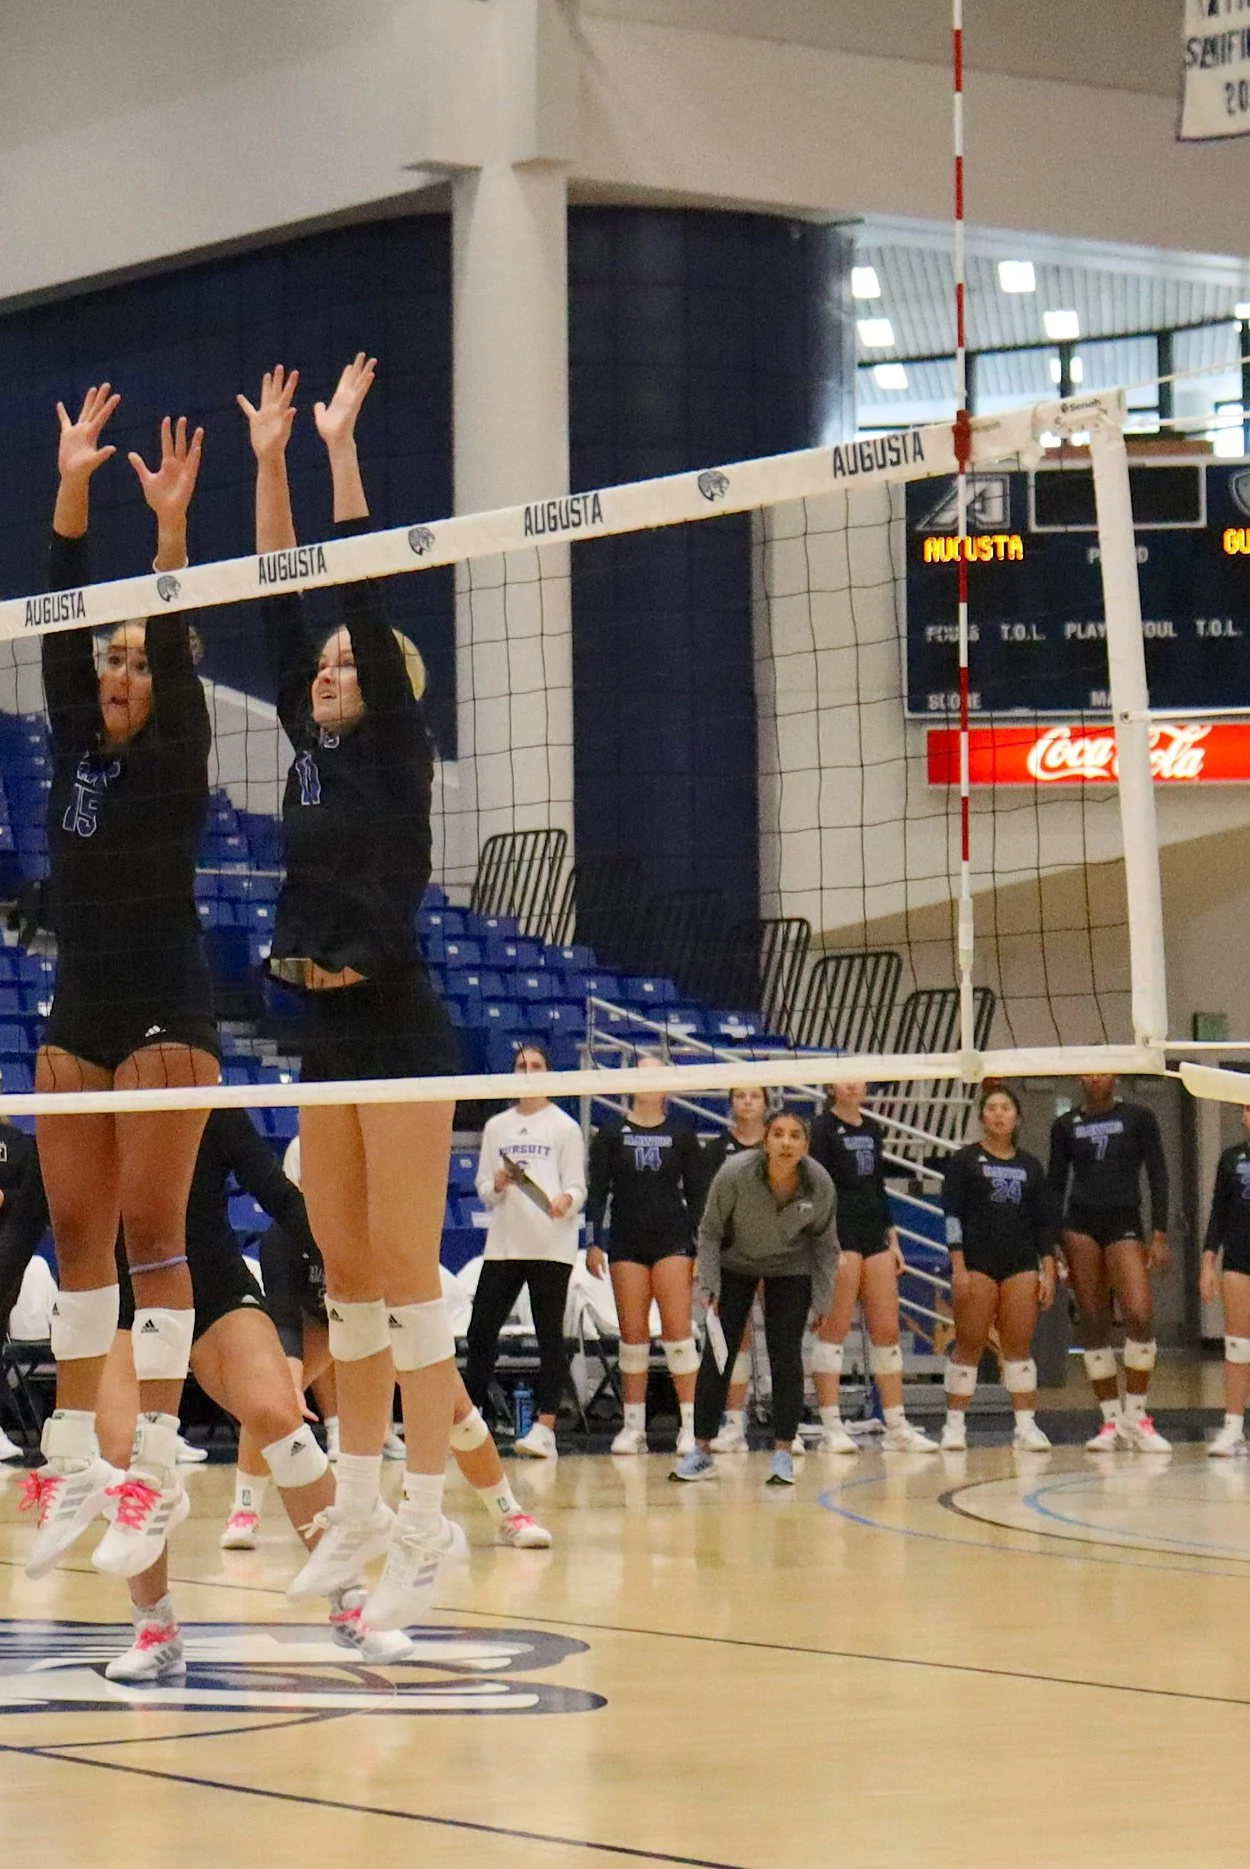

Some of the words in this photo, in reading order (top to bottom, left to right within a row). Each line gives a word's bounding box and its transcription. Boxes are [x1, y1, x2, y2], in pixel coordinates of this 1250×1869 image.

[832, 430, 925, 479] AUGUSTA
[524, 493, 604, 536] AUGUSTA
[258, 546, 327, 586] AUGUSTA
[25, 591, 86, 627] AUGUSTA
[62, 782, 103, 837] 15
[634, 1147, 662, 1171] 14
[991, 1178, 1022, 1204] 24
